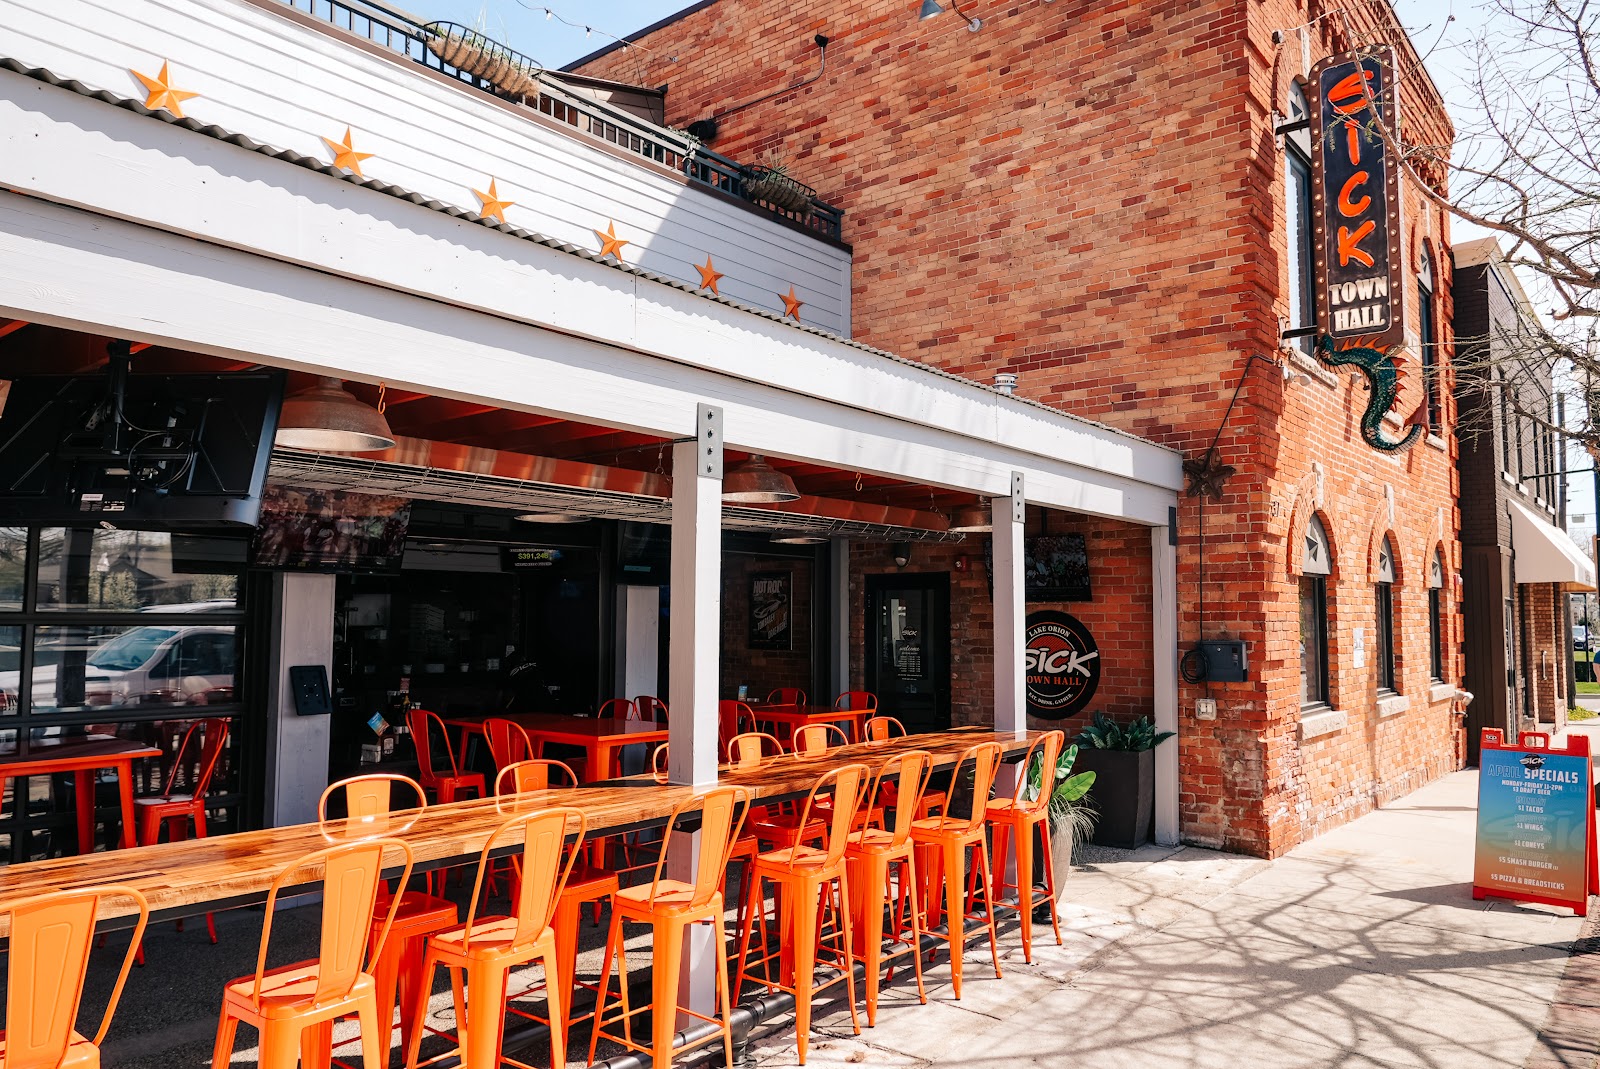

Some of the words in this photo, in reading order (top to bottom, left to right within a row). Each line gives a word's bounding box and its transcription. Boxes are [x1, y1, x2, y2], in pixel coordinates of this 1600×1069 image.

[1327, 70, 1376, 268] SICK
[1328, 275, 1389, 305] TOWN
[1333, 304, 1386, 332] HALL
[753, 580, 767, 594] HOT
[1028, 625, 1047, 638] LAKE
[1047, 625, 1071, 638] ORION
[1026, 675, 1051, 685] OWN
[1053, 676, 1082, 686] HALL
[1519, 757, 1547, 765] SICK
[1487, 763, 1521, 779] APRIL
[1524, 767, 1579, 784] SPECIALS
[1502, 780, 1543, 789] MONDAY-FRIDAY
[1519, 787, 1537, 795] DRAFT
[1537, 788, 1551, 796] BEER
[1518, 804, 1525, 812] $1
[1526, 805, 1544, 814] TACOS
[1524, 823, 1544, 832] WINGS
[1522, 840, 1545, 850] CONEYS
[1507, 857, 1527, 866] SMASH
[1528, 859, 1553, 870] BURGER
[1491, 873, 1498, 881] $5
[1499, 874, 1516, 883] PIZZA
[1524, 878, 1565, 890] BREADSTICKS
